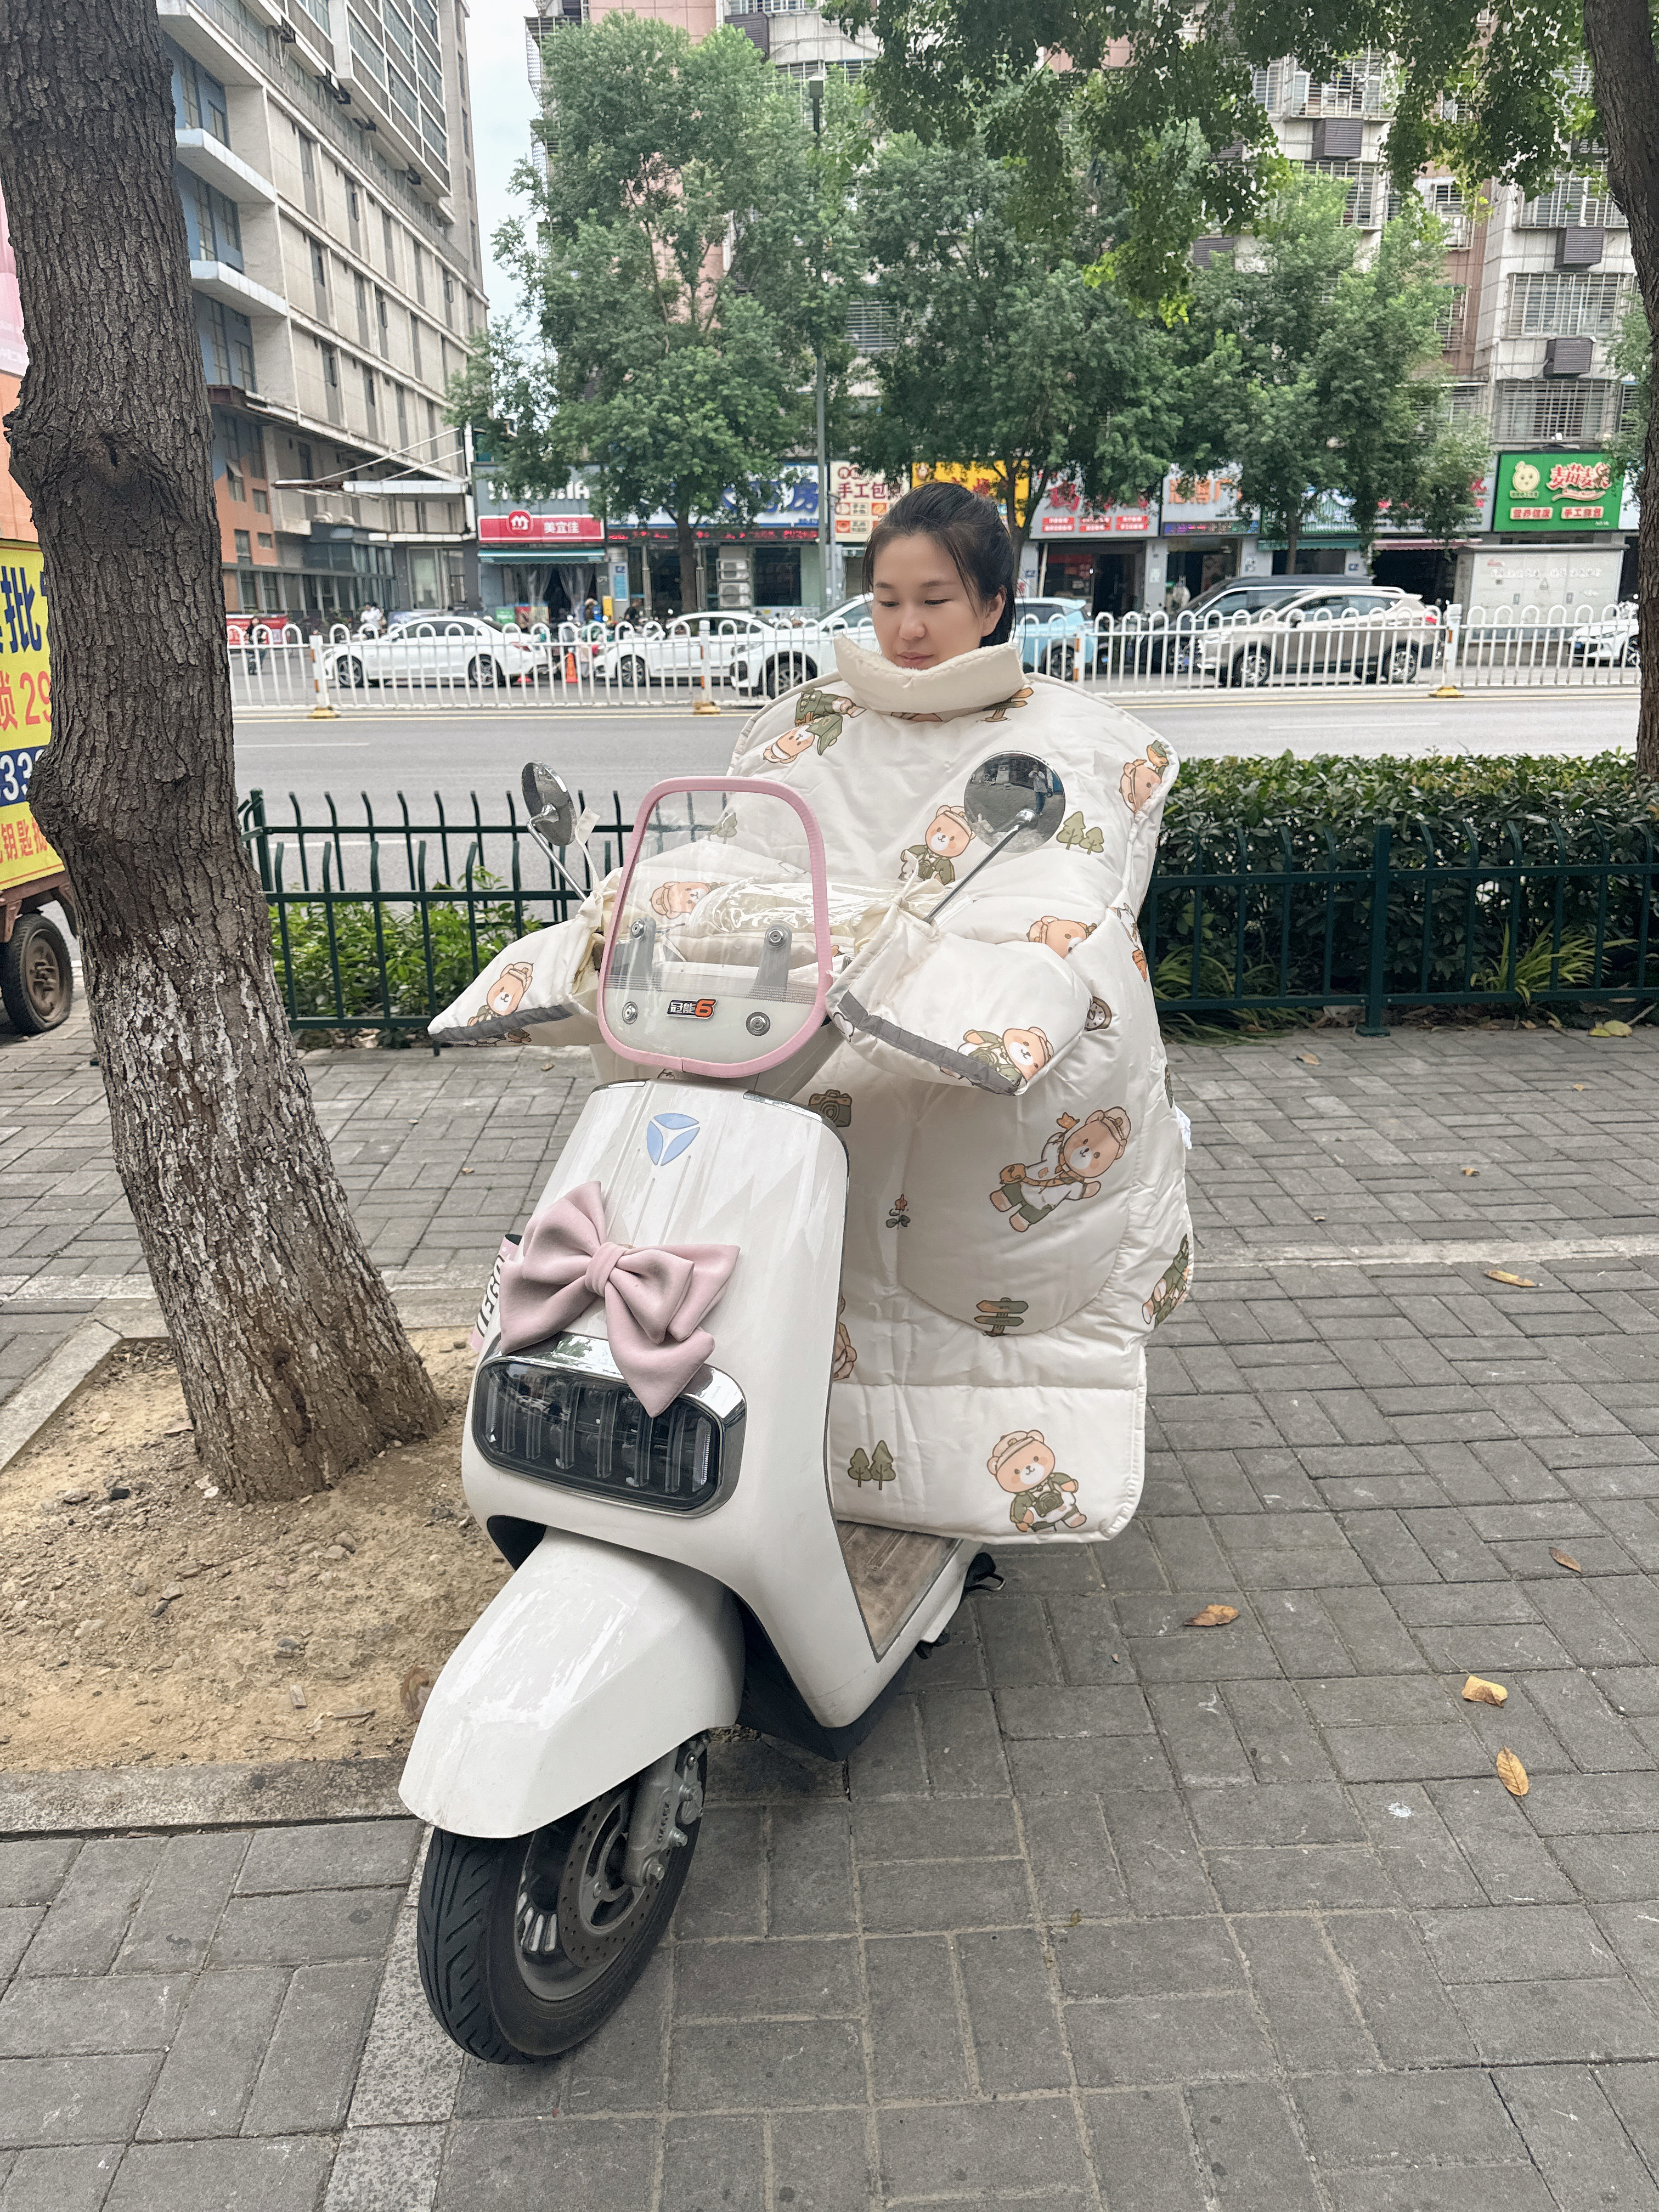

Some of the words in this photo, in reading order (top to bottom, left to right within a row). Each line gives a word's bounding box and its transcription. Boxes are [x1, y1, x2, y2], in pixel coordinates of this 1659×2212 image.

[543, 521, 580, 534] 美宜佳
[670, 998, 716, 1018] 冠能6
